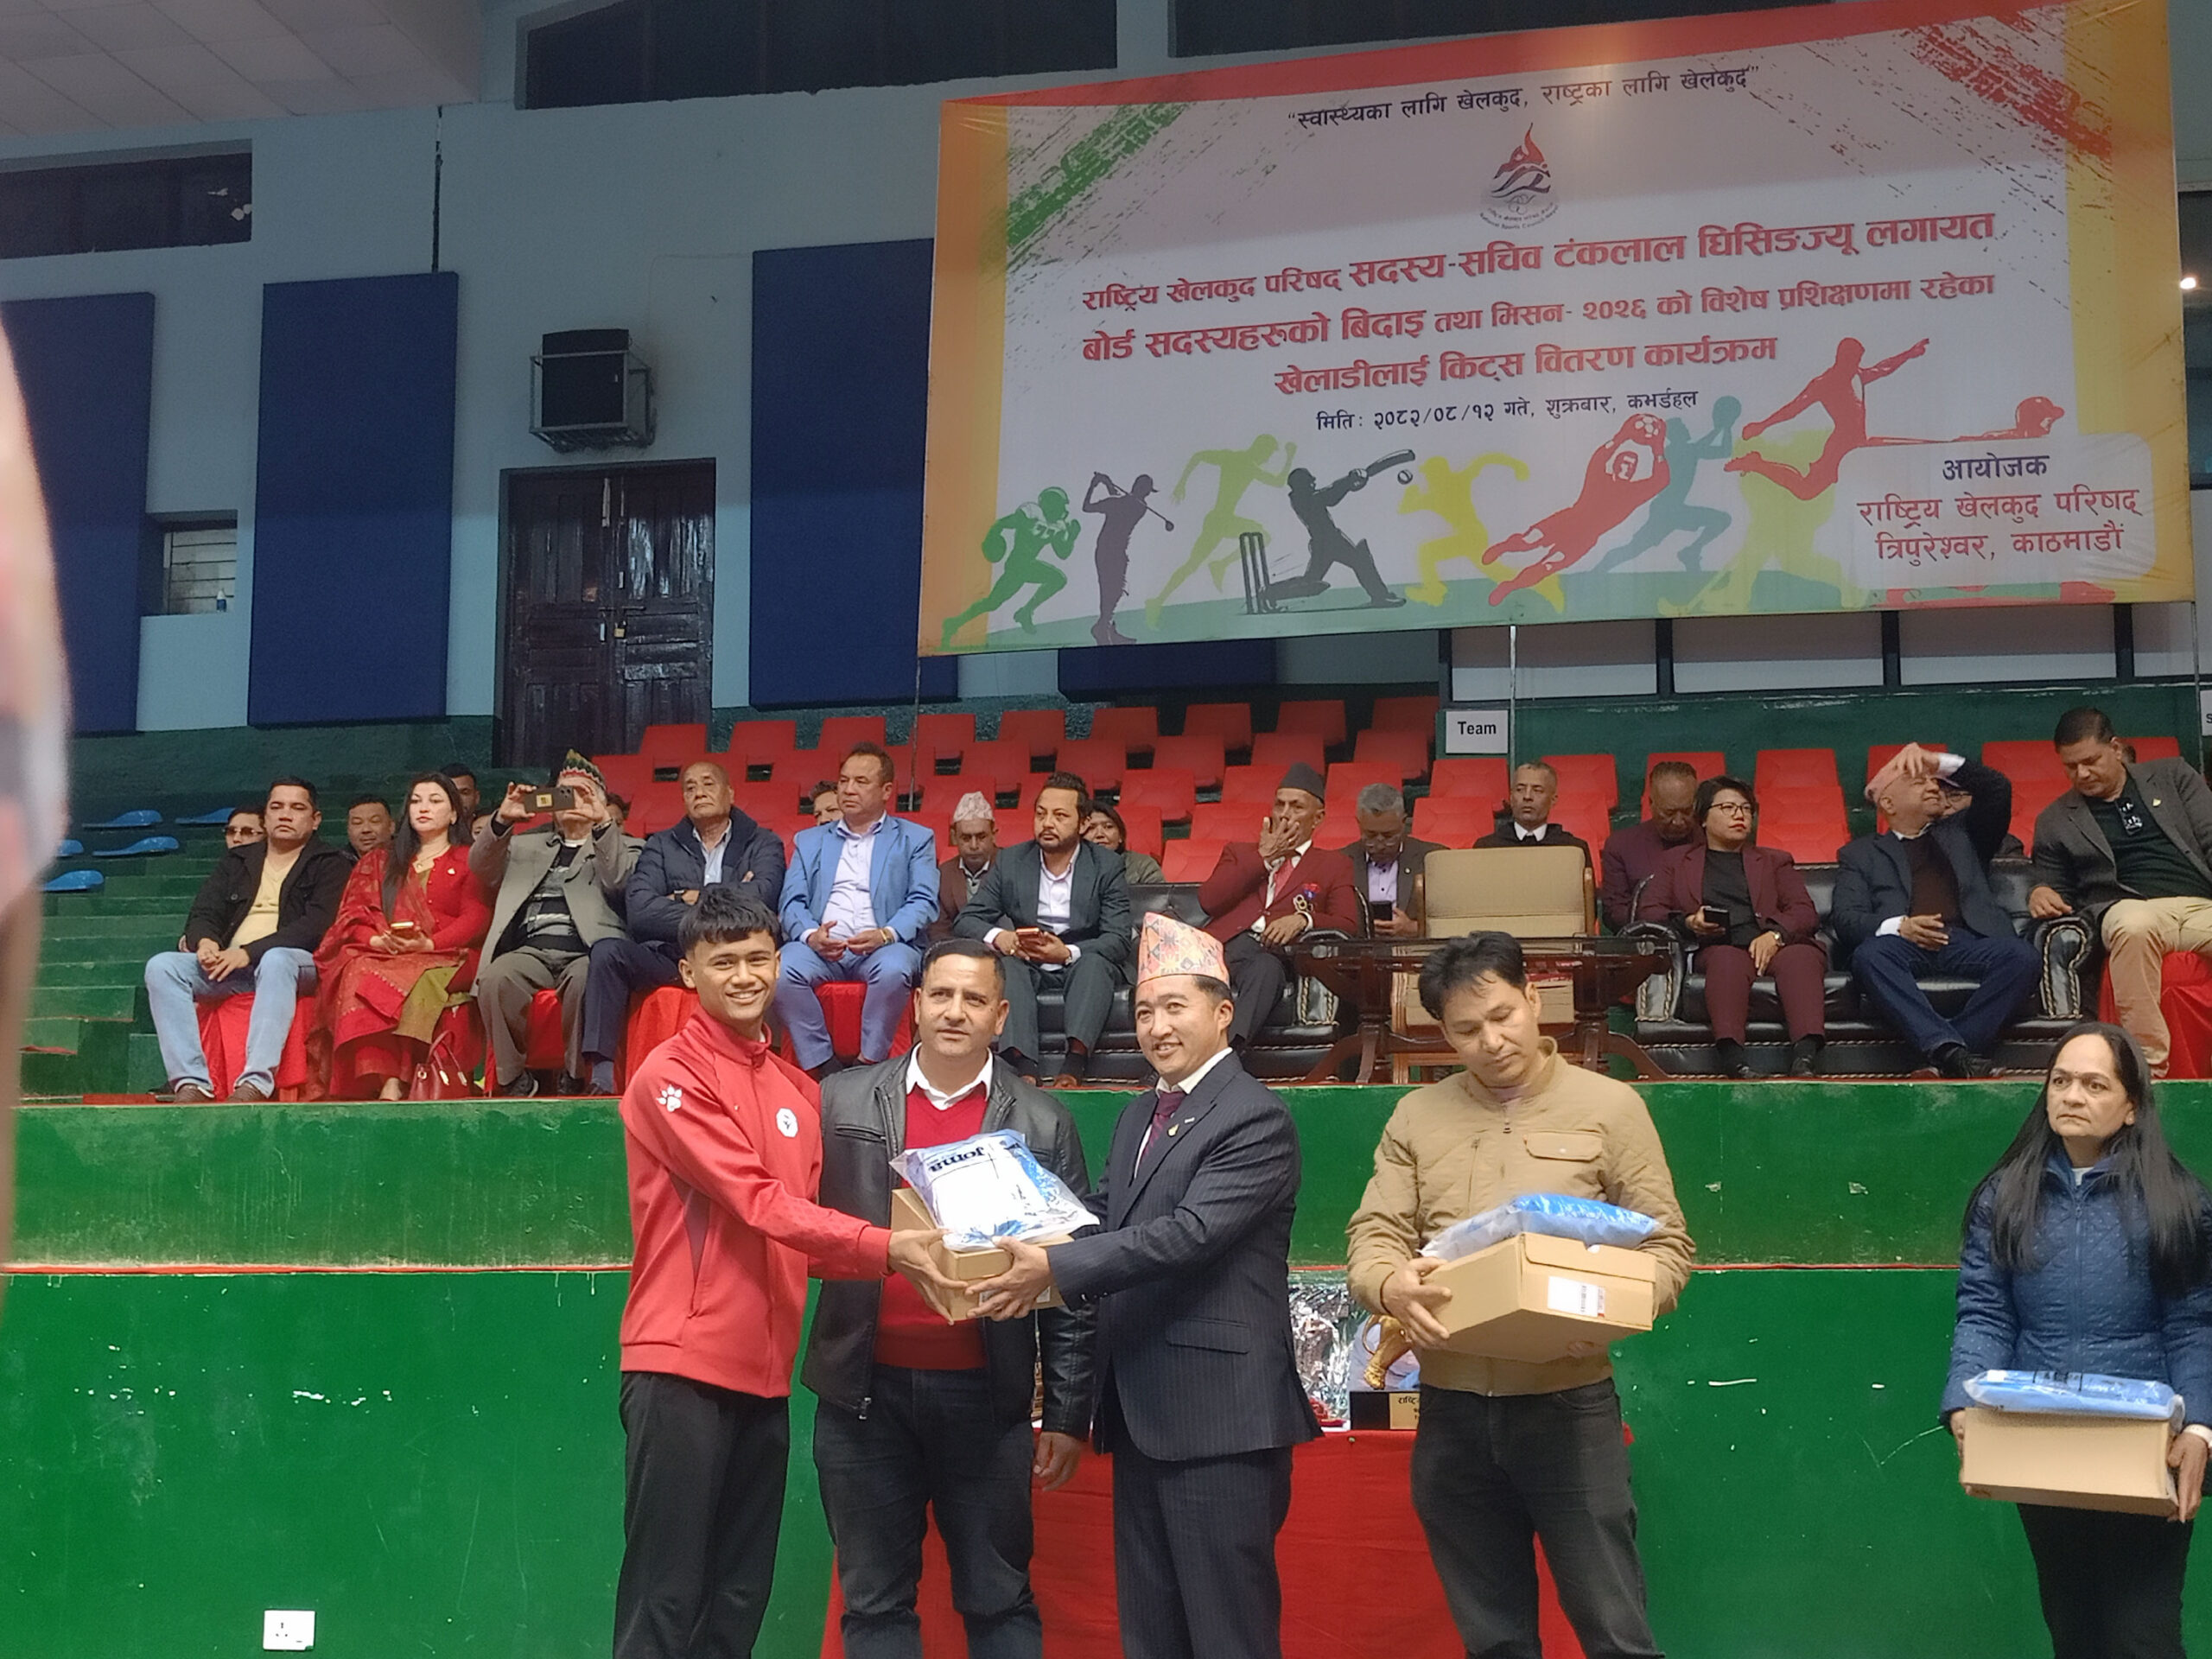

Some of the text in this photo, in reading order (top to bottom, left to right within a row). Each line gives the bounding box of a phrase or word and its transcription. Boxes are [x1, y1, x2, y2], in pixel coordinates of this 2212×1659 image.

[1401, 92, 1447, 118] लागि
[1458, 88, 1528, 112] खेलकुद,
[1541, 80, 1612, 105] राष्ट्रका
[1622, 70, 1670, 97] लागि
[1083, 283, 1160, 312] राष्ट्रिय
[1166, 277, 1256, 302] खेलकुद
[1554, 237, 1687, 269] टंकलाल
[1698, 222, 1859, 257] घिसिङज्यू
[1866, 213, 1995, 248] लगायत
[1083, 329, 1135, 361] बोर्ड
[1342, 307, 1427, 339] बिदाइ
[1435, 309, 1484, 333] तथा
[1583, 298, 1647, 321] २०२६
[1657, 290, 1691, 316] को
[1701, 286, 1769, 314] विशेष
[1778, 280, 1910, 312] प्रशिक्षणमा
[1920, 271, 1994, 300] रहेका
[1274, 335, 1777, 395] खेलाडीलाई किट्स वितरण कार्यक्रम
[1504, 397, 1535, 418] गते,
[1546, 396, 1616, 419] शुक्रबार,
[1627, 387, 1699, 410] कभर्डहल
[1942, 453, 2050, 480] आयोजक
[1857, 493, 1942, 529] राष्ट्रिय
[1955, 492, 2042, 524] खेलकुद
[1875, 519, 2125, 567] त्रिपुरेश्वर, काठमाडौं
[1457, 721, 1497, 734] Team
